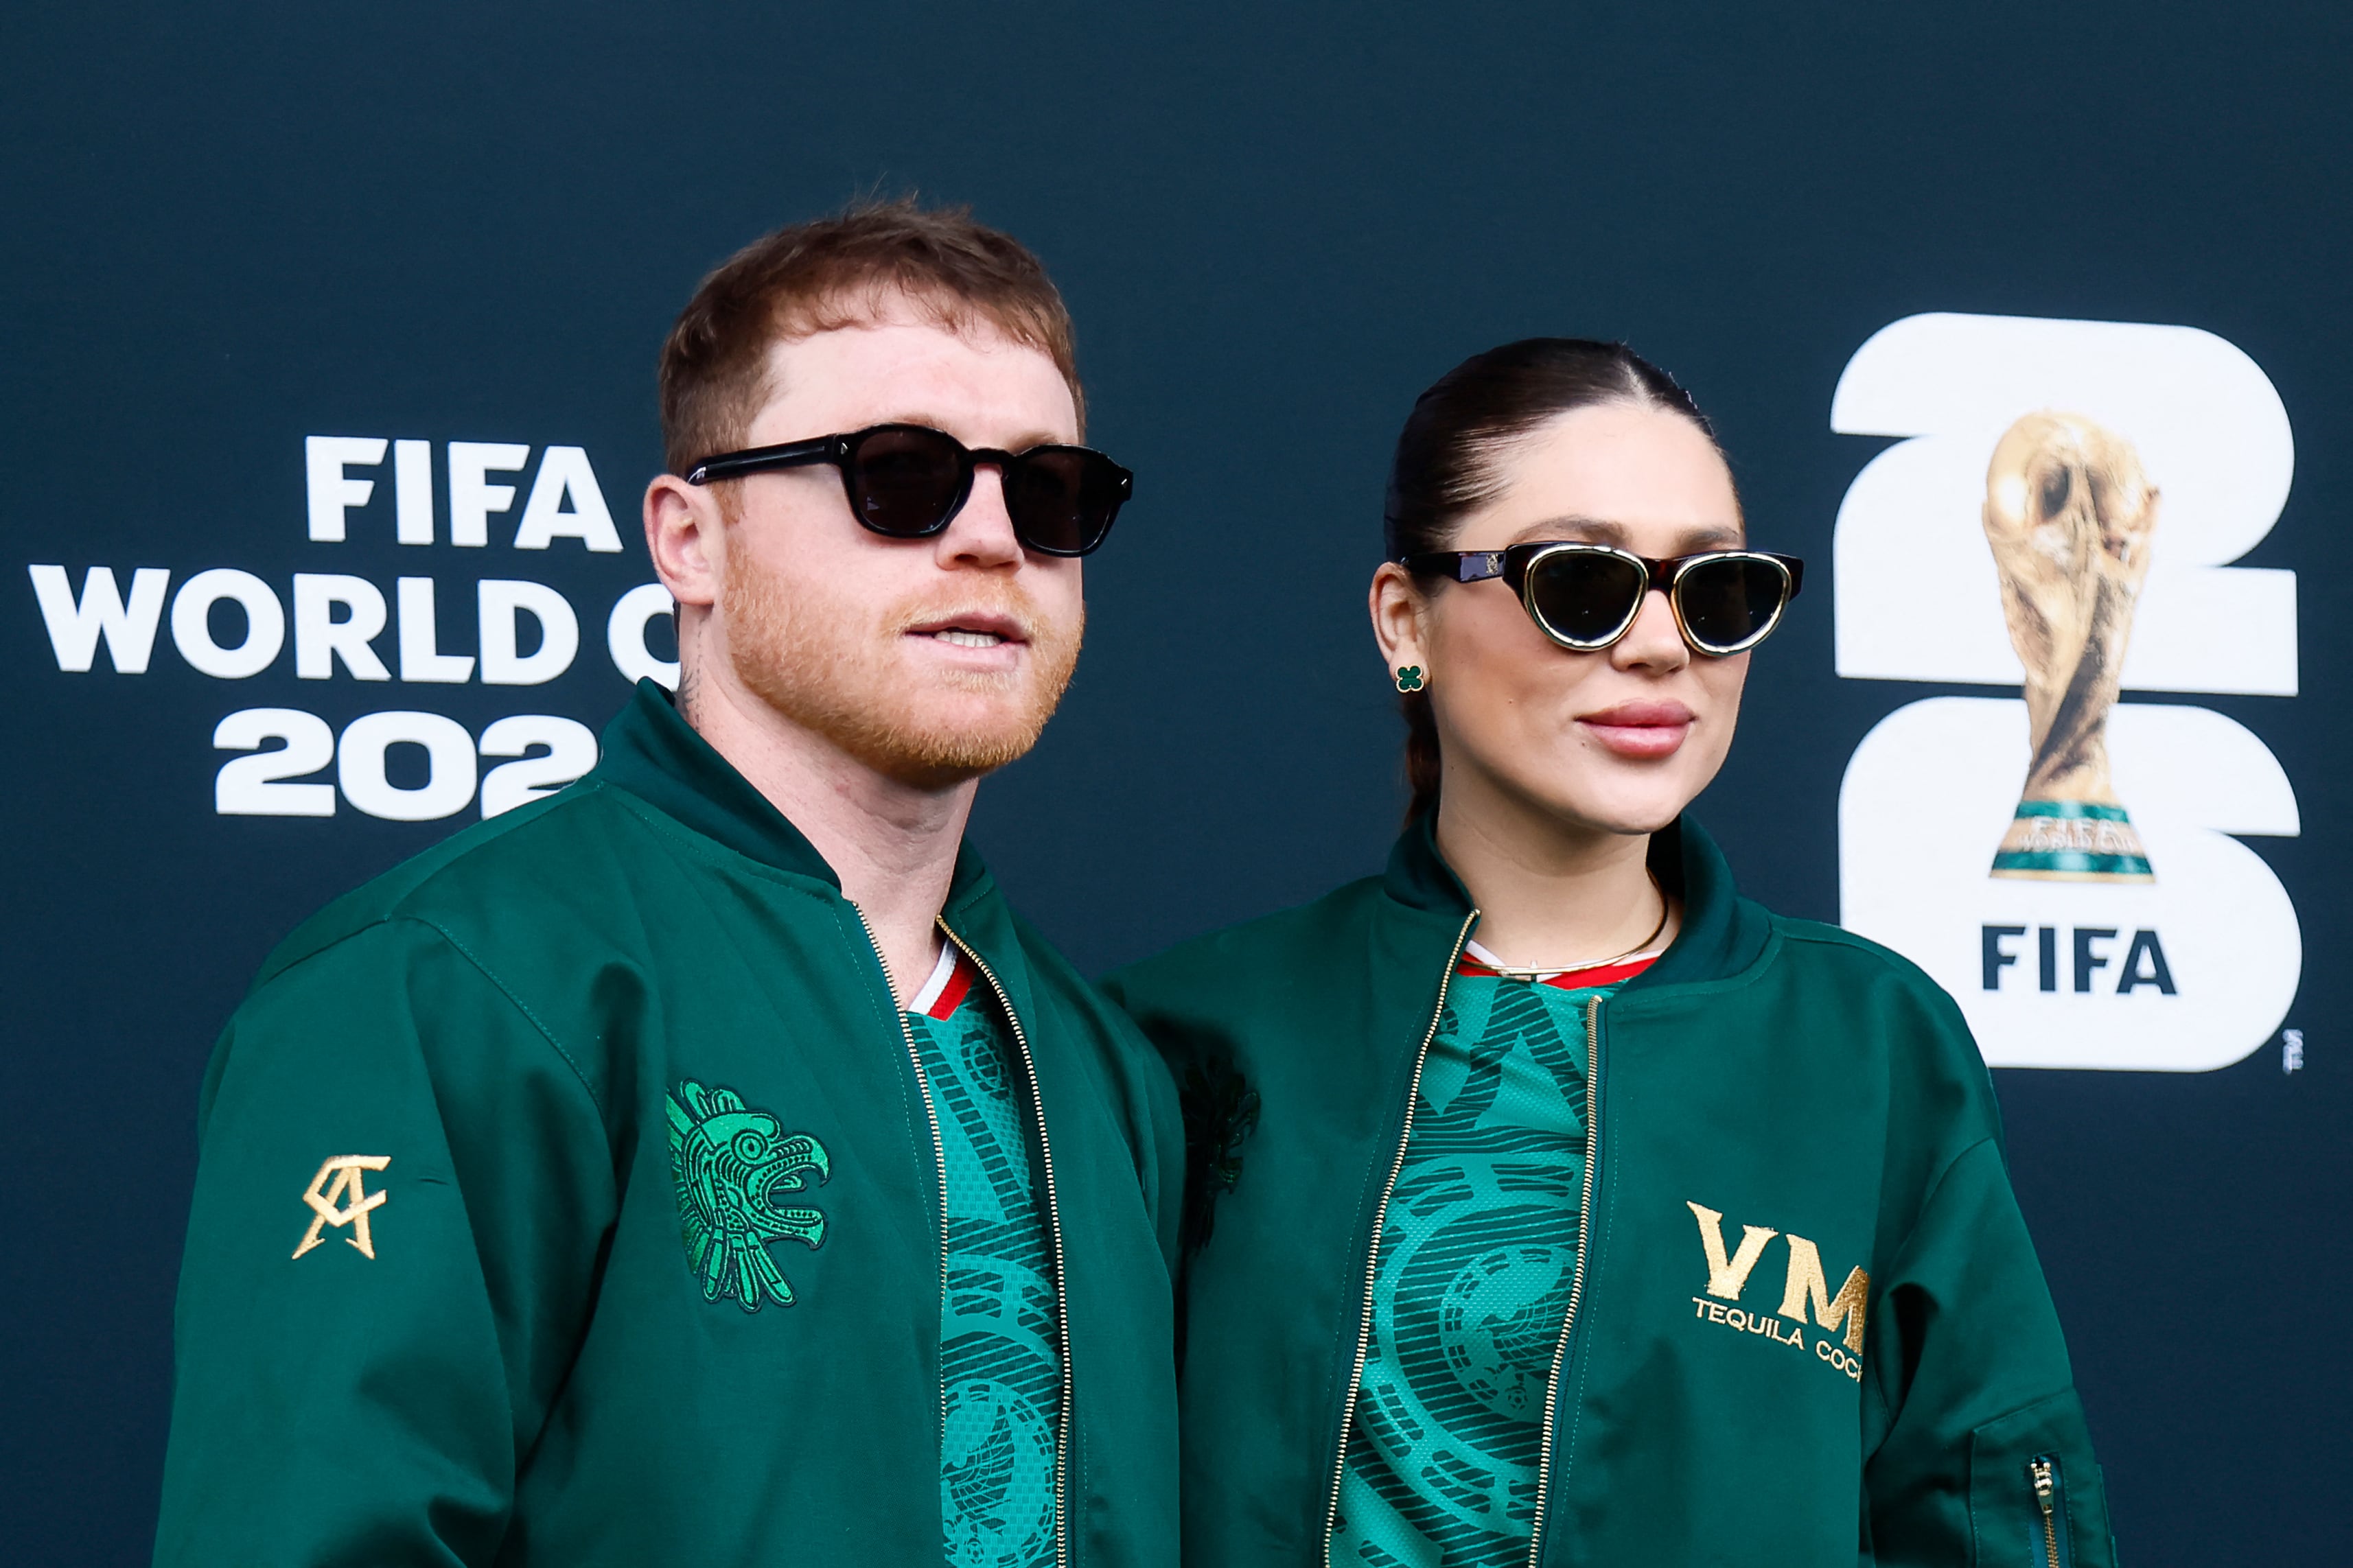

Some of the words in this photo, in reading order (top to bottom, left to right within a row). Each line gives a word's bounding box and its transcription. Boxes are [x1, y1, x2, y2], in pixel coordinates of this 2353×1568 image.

[305, 435, 624, 552] FIFA
[28, 563, 579, 685] WORLD
[213, 707, 599, 821] 202
[1981, 924, 2179, 996] FIFA
[1691, 1296, 1806, 1351] TEQUILA
